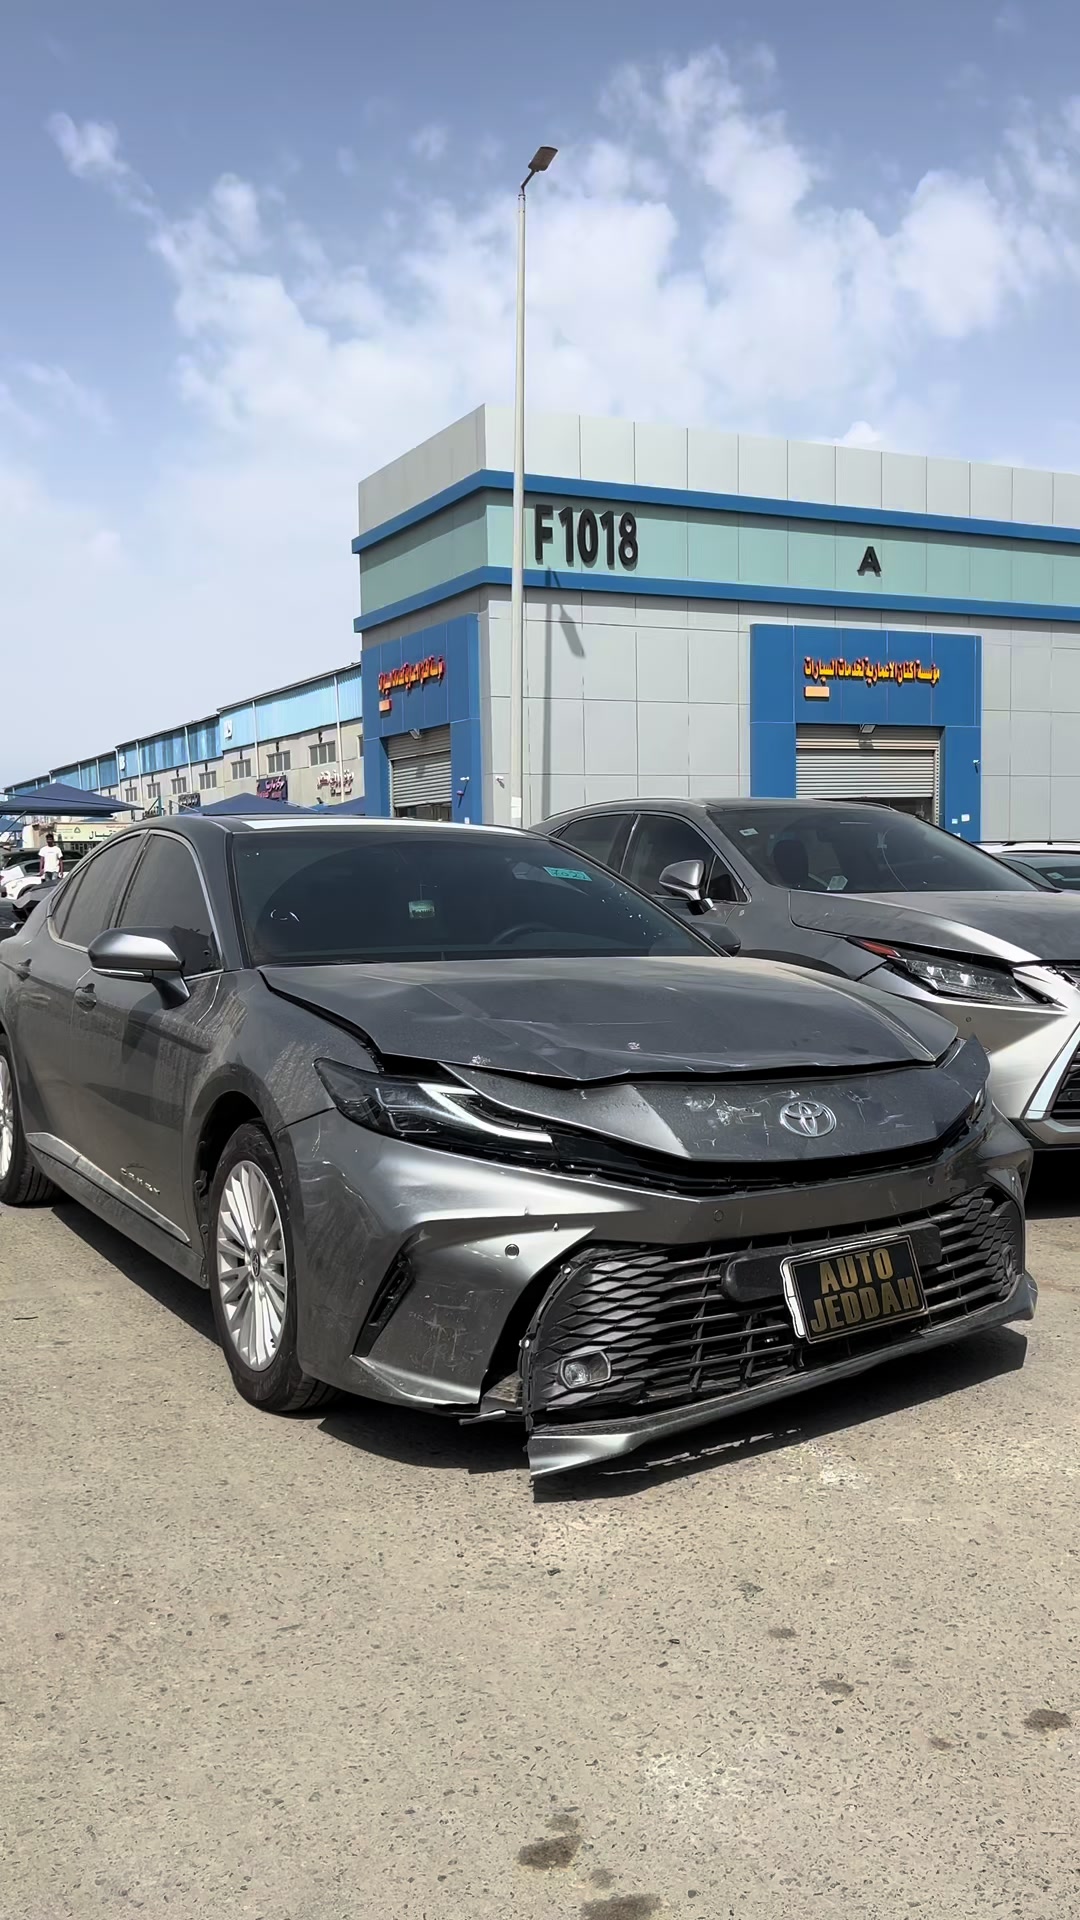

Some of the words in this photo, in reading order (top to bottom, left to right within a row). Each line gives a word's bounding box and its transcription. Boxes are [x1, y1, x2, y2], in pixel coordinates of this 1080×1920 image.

[534, 503, 638, 569] F1018
[857, 546, 882, 576] A
[804, 656, 838, 682] السيارات
[819, 1248, 894, 1294] AUTO
[810, 1277, 919, 1333] JEDDAH
